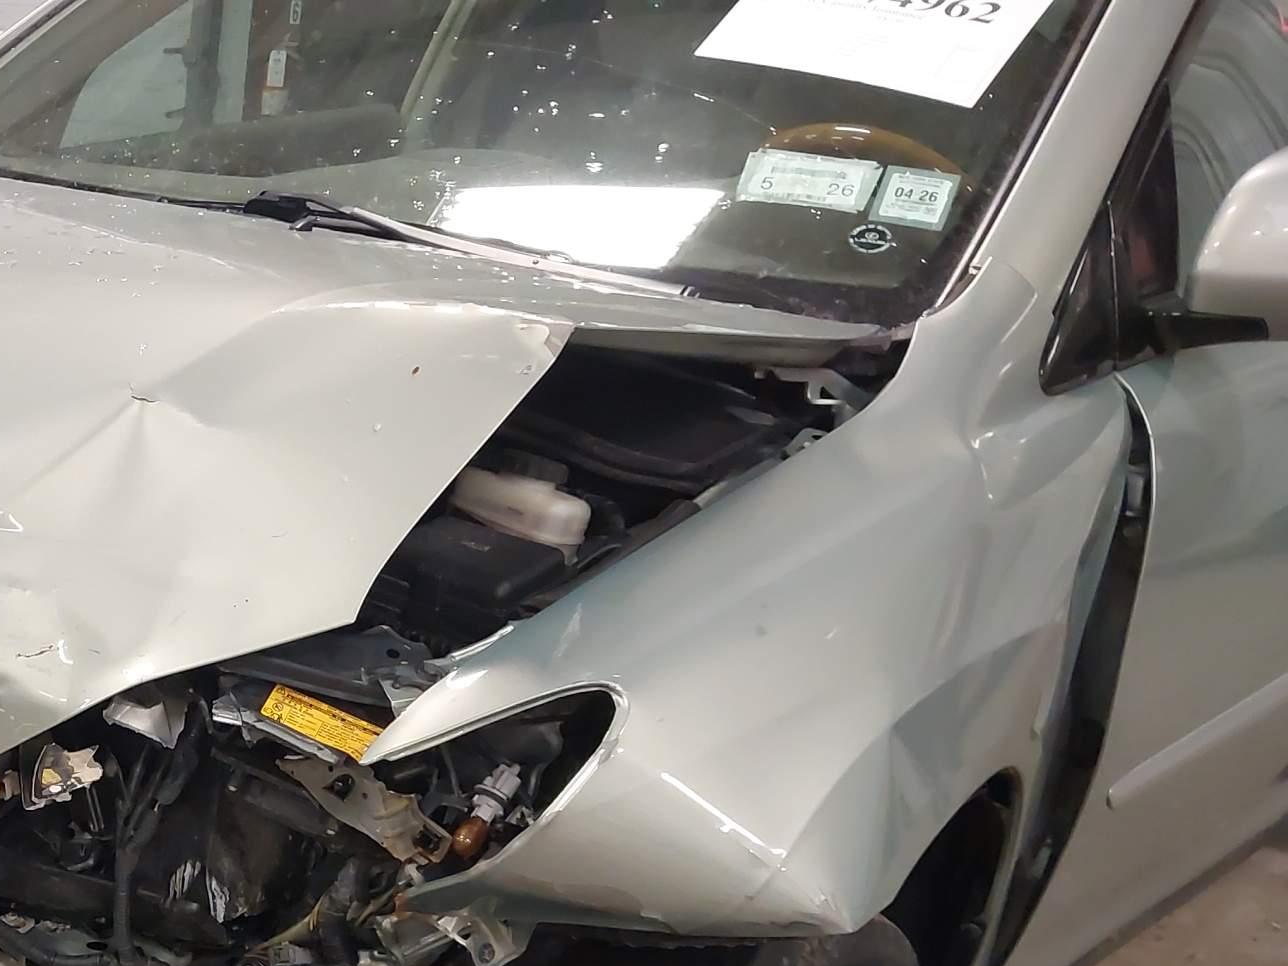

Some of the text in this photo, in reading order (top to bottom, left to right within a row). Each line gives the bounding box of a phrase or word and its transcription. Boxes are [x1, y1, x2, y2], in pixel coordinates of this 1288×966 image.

[760, 176, 856, 198] 5 26
[894, 186, 940, 203] 04 26
